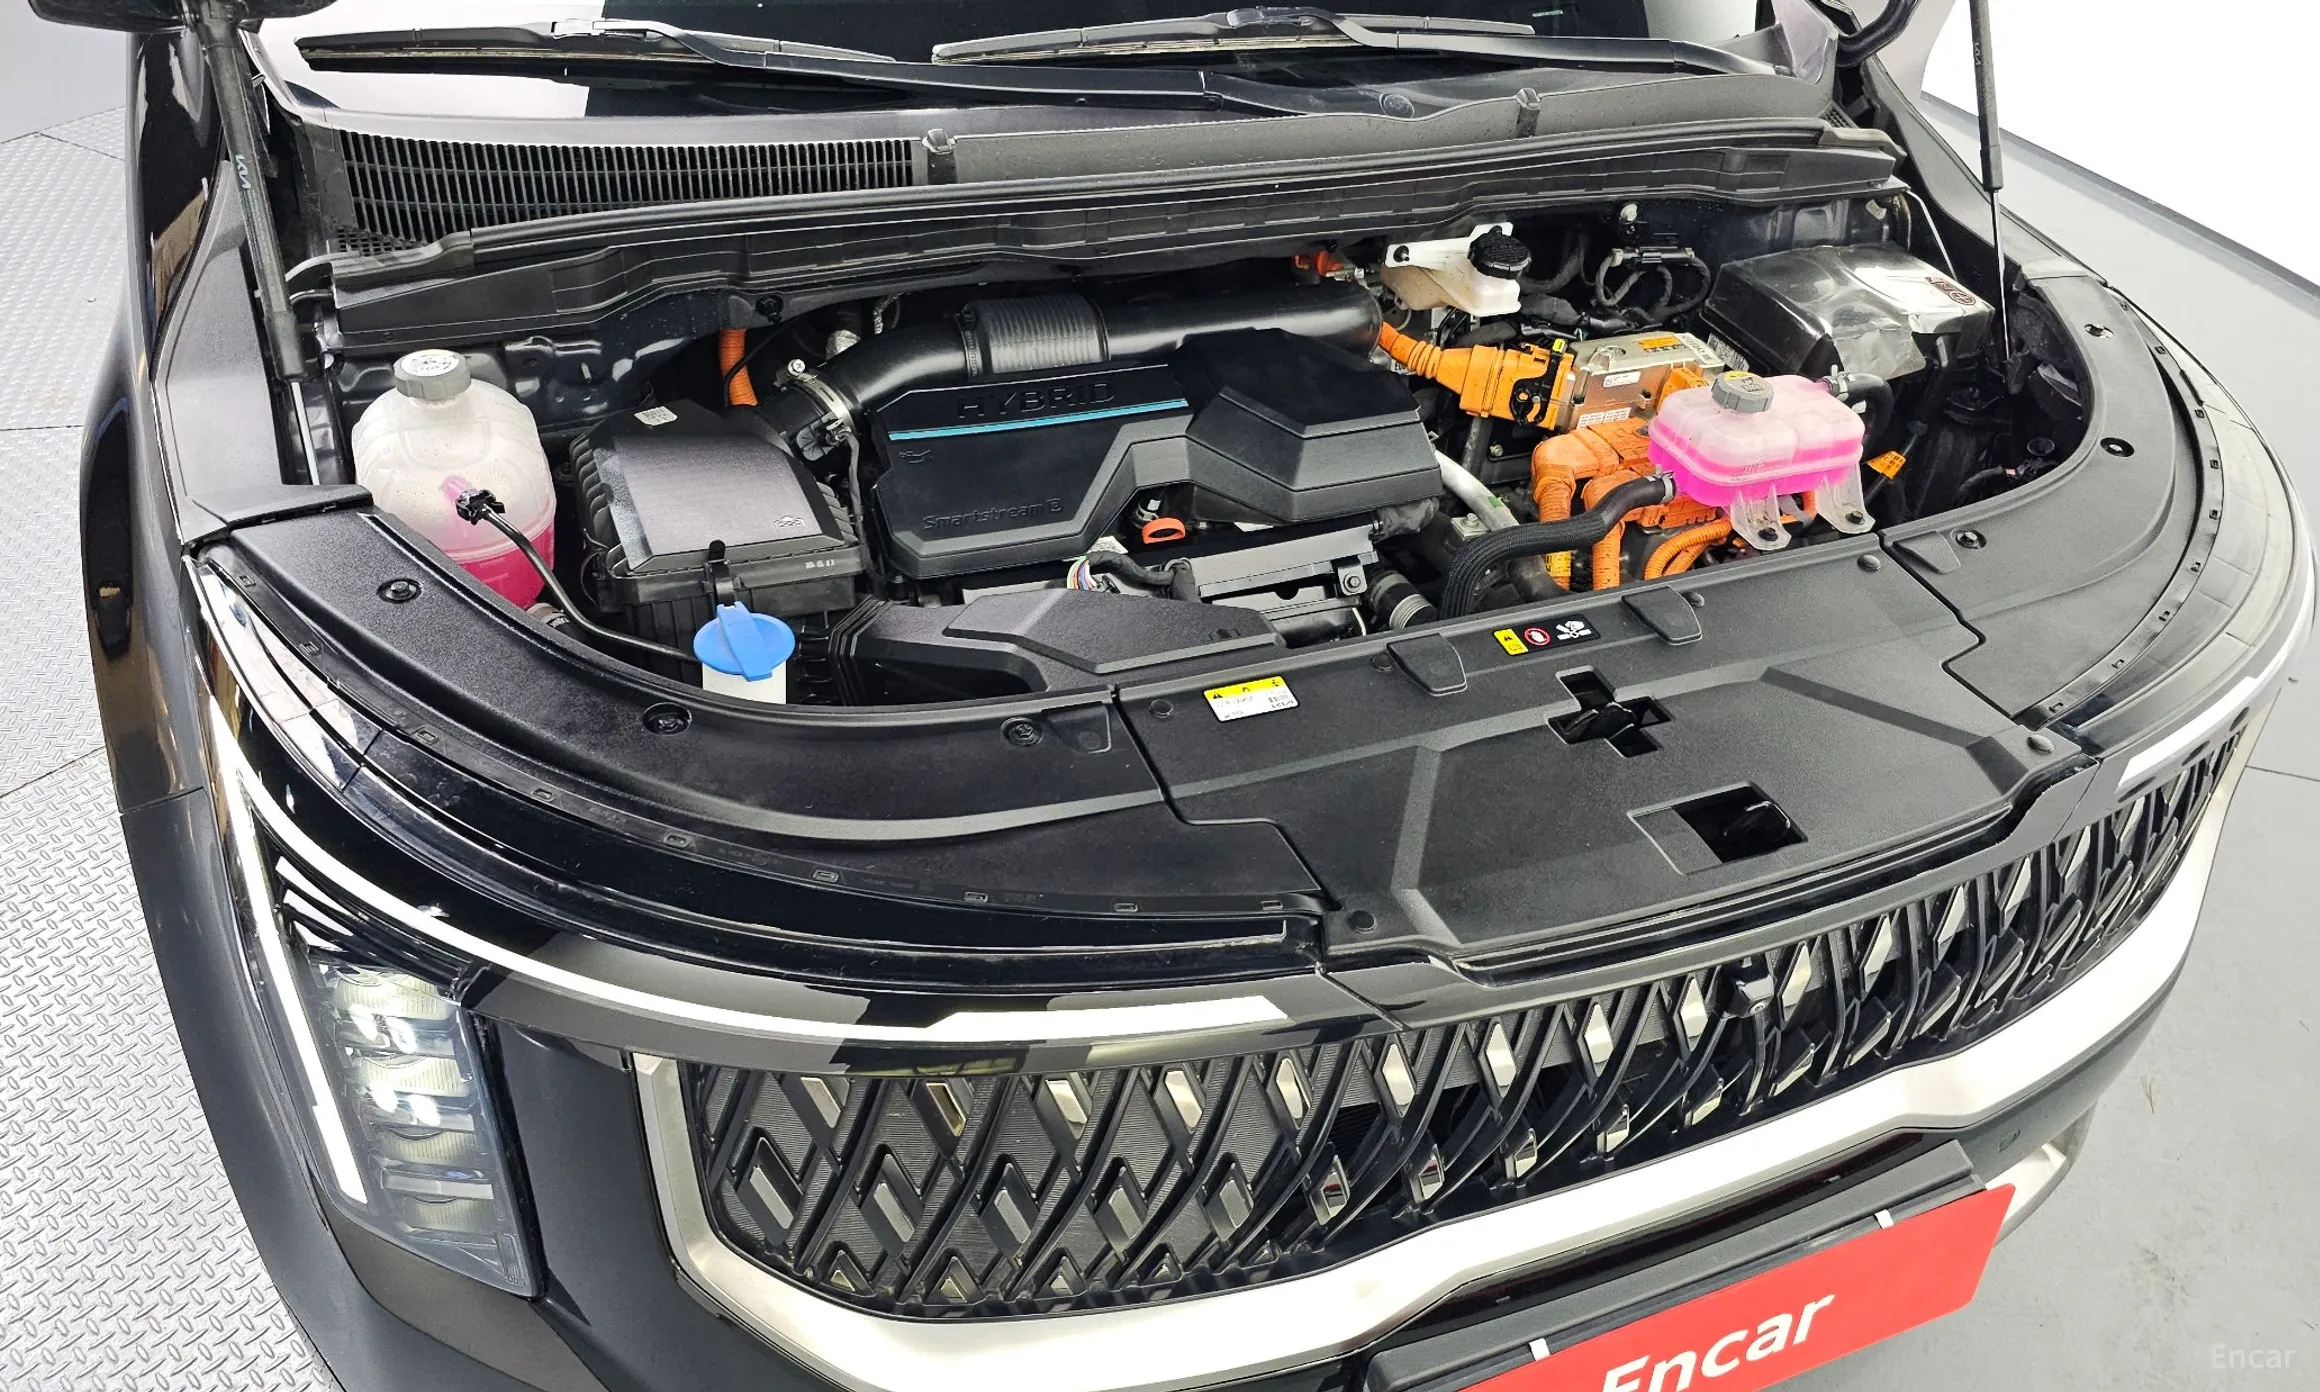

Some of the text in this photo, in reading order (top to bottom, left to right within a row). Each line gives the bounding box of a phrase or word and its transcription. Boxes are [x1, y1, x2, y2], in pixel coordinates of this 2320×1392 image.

[235, 154, 251, 189] KIA
[957, 382, 1115, 419] HYBRID
[922, 502, 1043, 530] Smartstream
[1602, 1294, 1836, 1392] Encar
